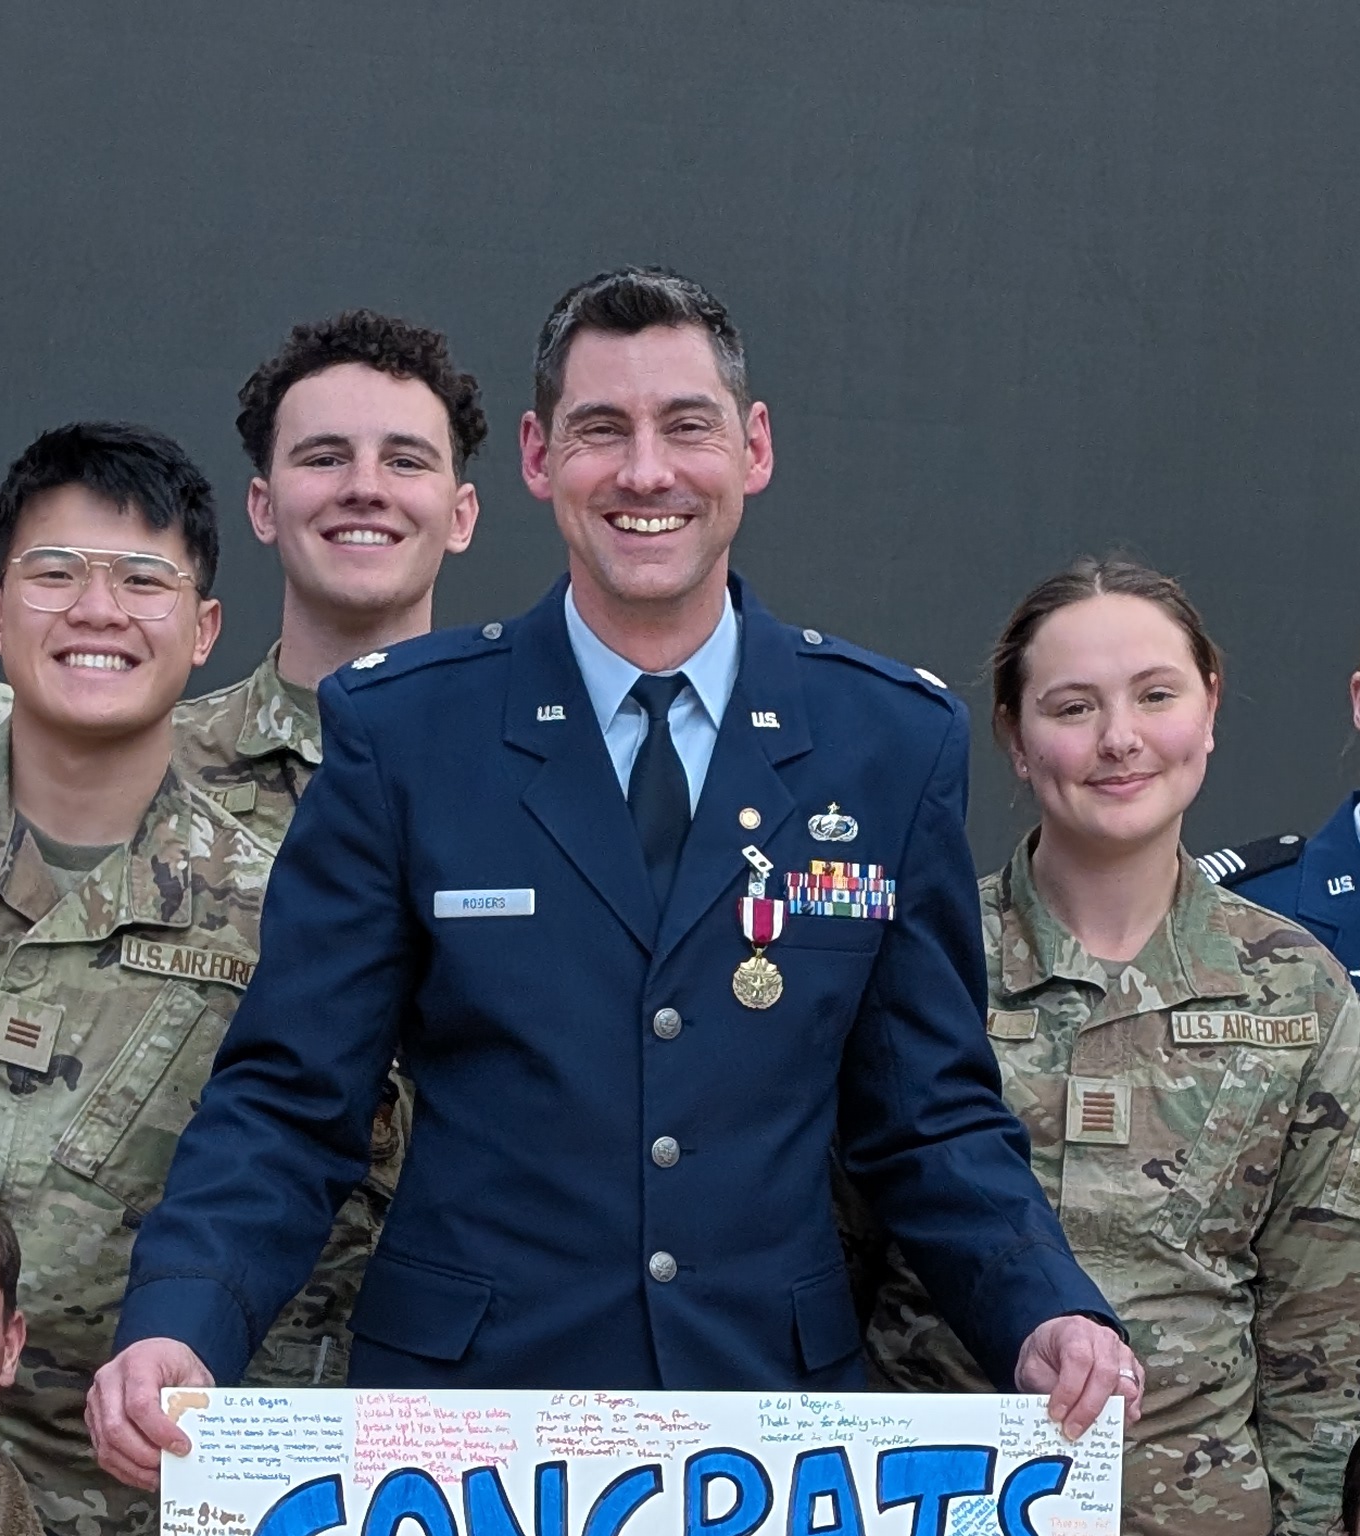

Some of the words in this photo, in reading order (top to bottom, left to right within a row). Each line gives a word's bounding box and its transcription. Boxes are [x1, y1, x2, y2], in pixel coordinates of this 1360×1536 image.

[126, 940, 166, 970] U.S.
[170, 949, 206, 976] AIR
[1177, 1014, 1218, 1040] U.S.
[1222, 1014, 1254, 1041] AIR
[1256, 1016, 1314, 1044] FORCE
